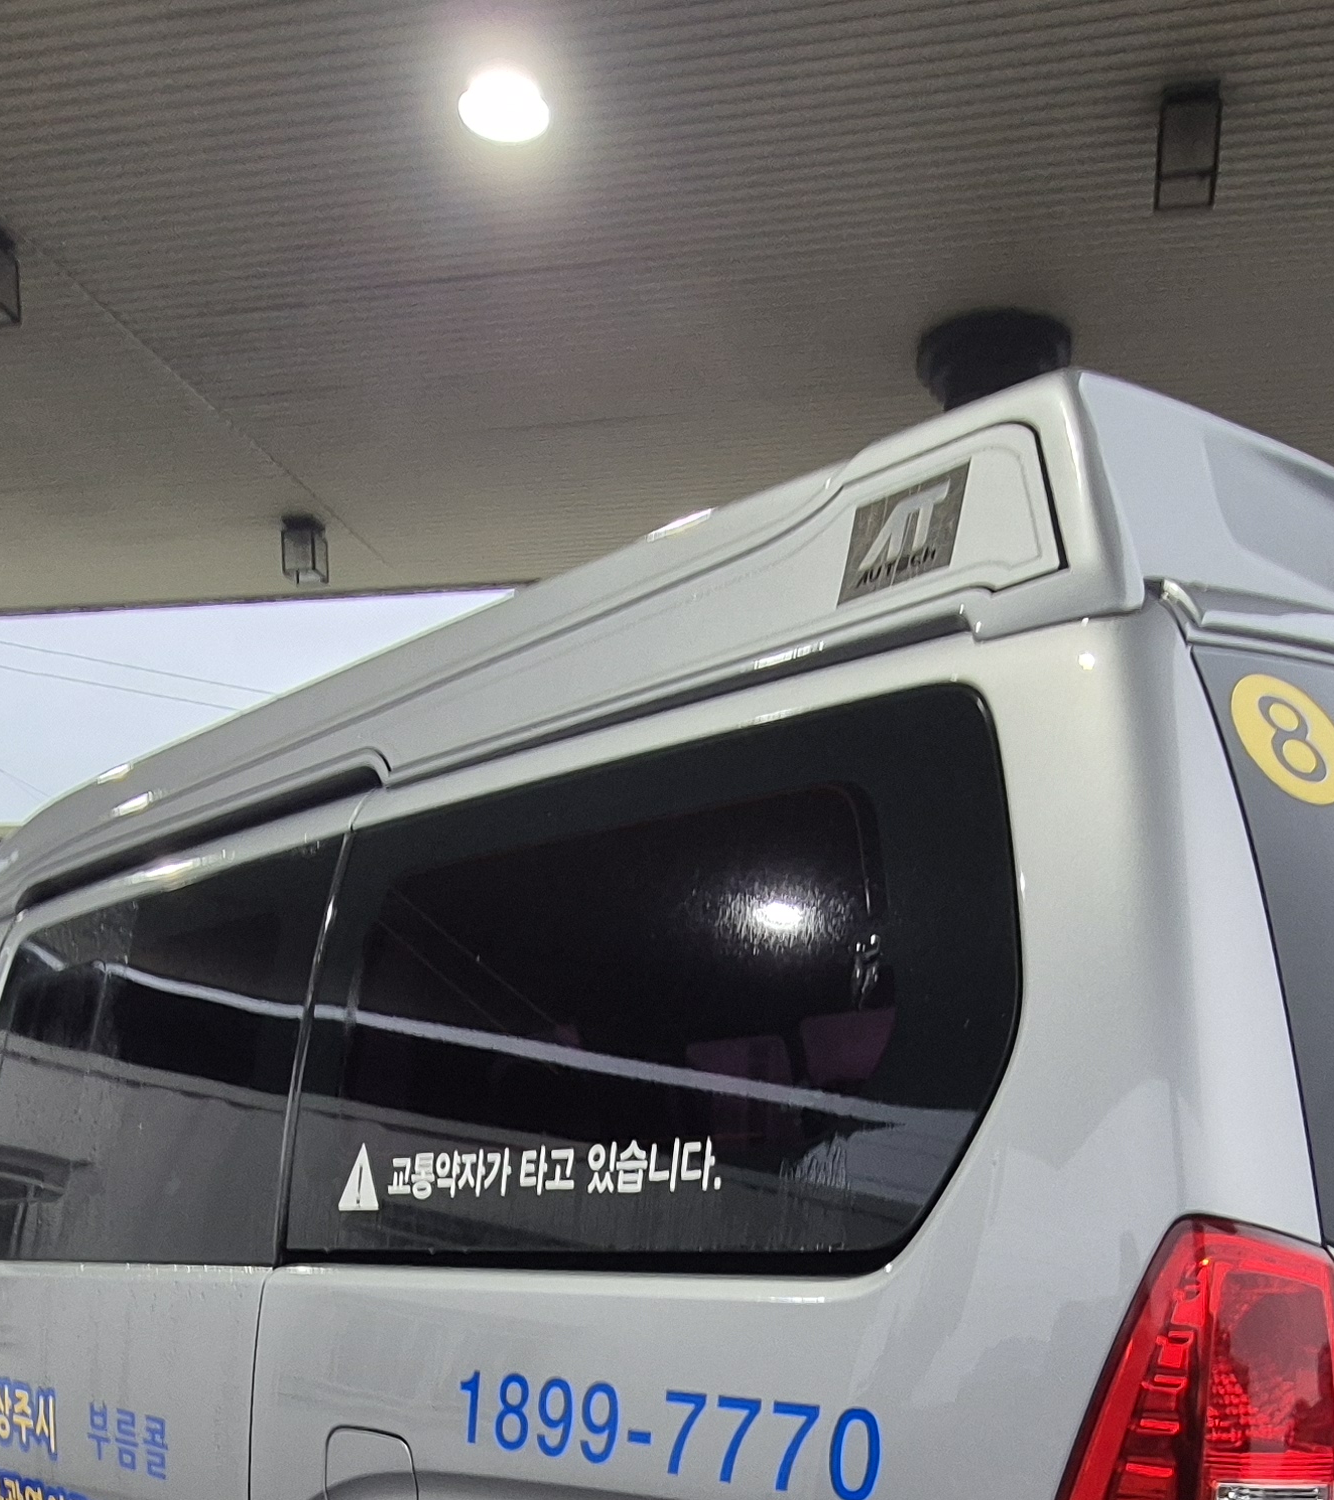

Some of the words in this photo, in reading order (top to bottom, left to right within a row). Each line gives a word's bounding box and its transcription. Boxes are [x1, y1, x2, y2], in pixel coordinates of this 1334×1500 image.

[855, 546, 937, 589] AUTCH
[1257, 695, 1328, 783] 8
[388, 1147, 512, 1200] 교통약자가
[520, 1144, 574, 1196] 타고
[587, 1135, 722, 1194] 있습니다.
[87, 1401, 169, 1480] 부름콜
